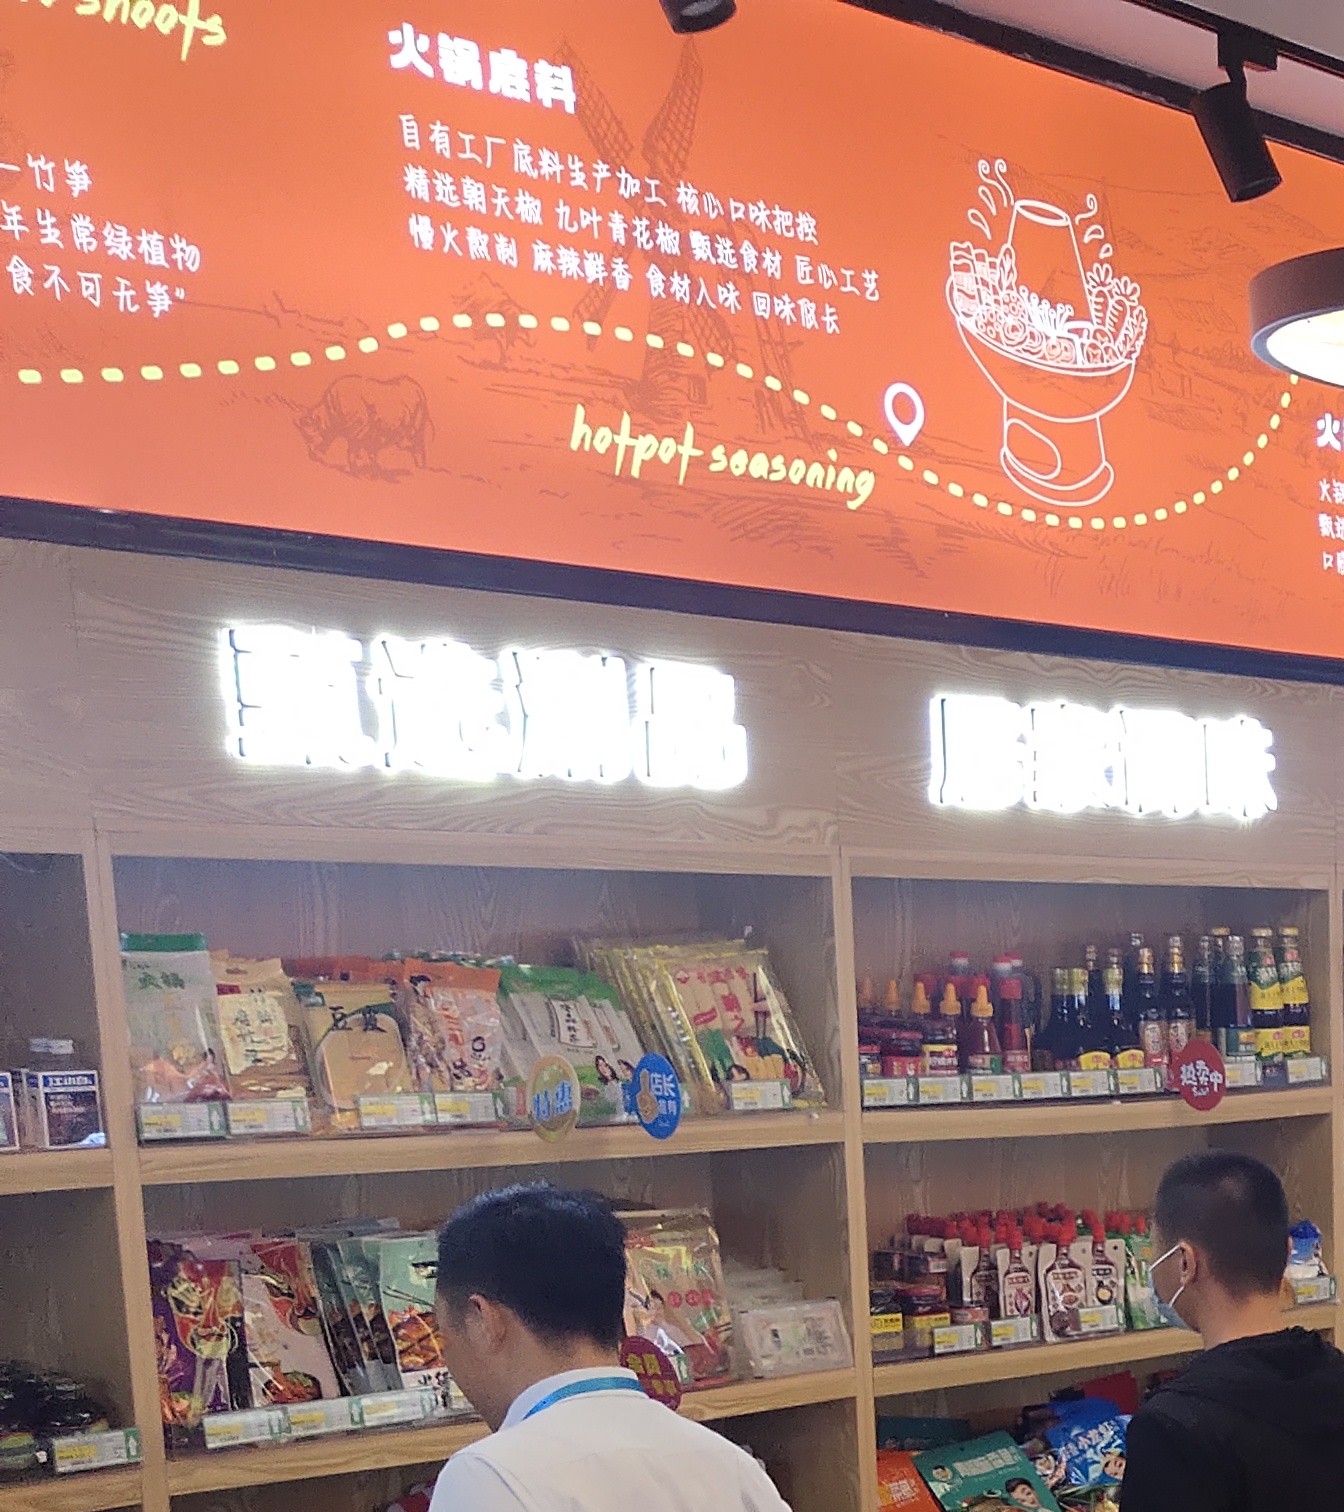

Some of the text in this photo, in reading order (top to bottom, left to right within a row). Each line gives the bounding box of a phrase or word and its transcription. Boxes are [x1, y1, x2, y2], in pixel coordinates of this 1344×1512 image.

[388, 22, 577, 113] 火锅底料
[531, 240, 633, 292] 麻辣鲜香
[645, 263, 741, 315] 食材入味
[555, 199, 681, 257] 九叶青花椒
[795, 254, 880, 301] 匠心工艺
